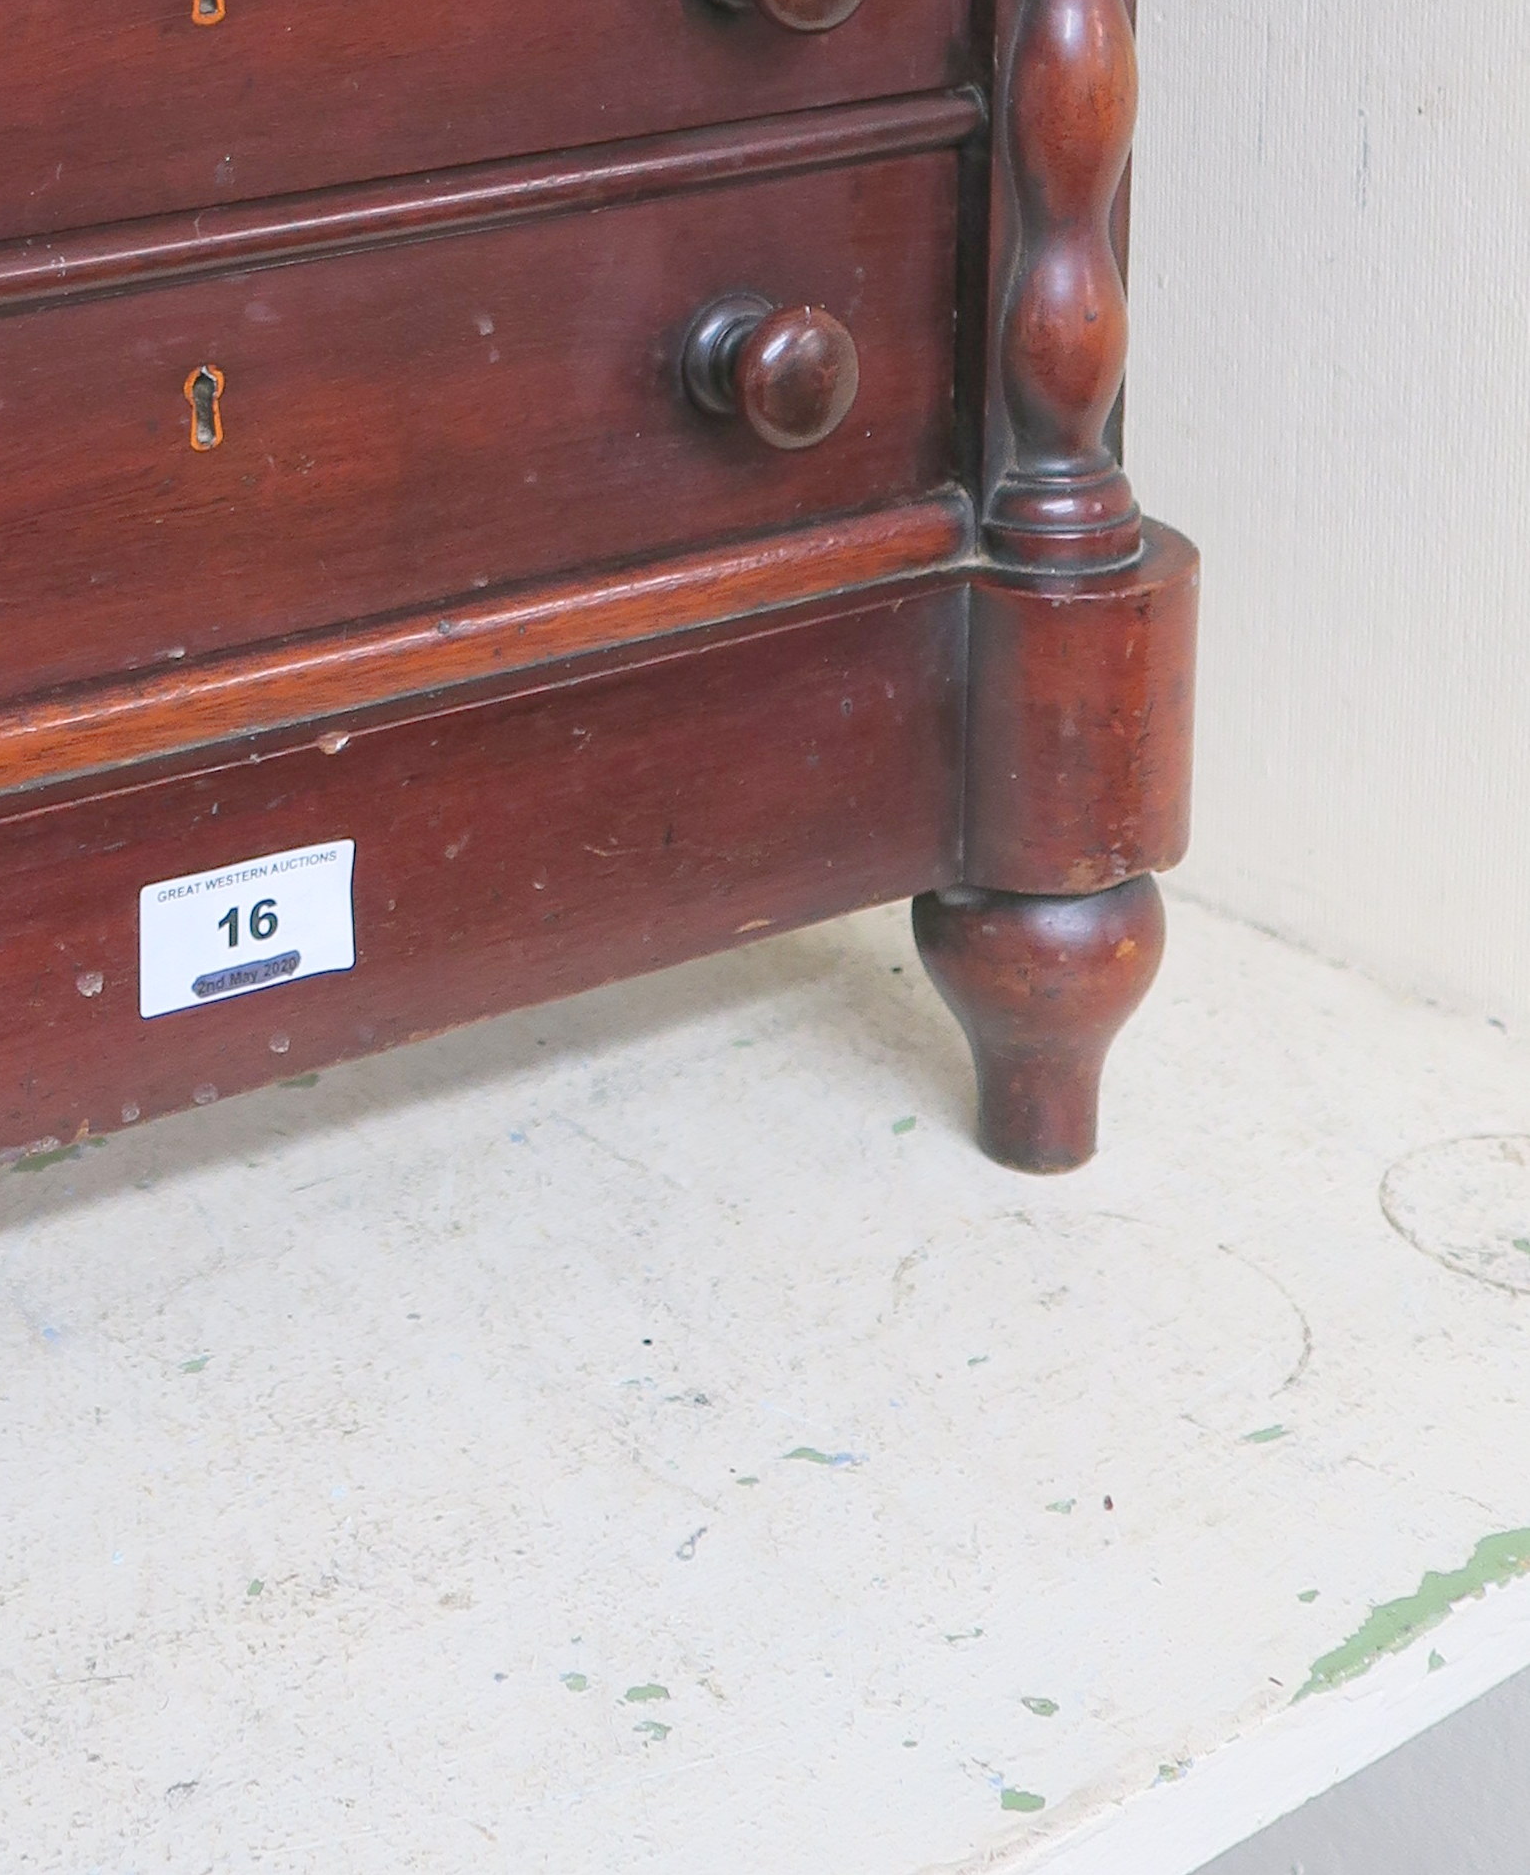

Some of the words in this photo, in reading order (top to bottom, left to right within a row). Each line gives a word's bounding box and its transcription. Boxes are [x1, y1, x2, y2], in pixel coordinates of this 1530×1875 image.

[157, 882, 202, 903] GREAT
[205, 866, 268, 891] WESTERN
[271, 850, 337, 875] AUCTIONS
[217, 898, 278, 949] 16
[197, 977, 225, 996] 2nd
[229, 970, 258, 985] May
[263, 957, 297, 977] 2020
